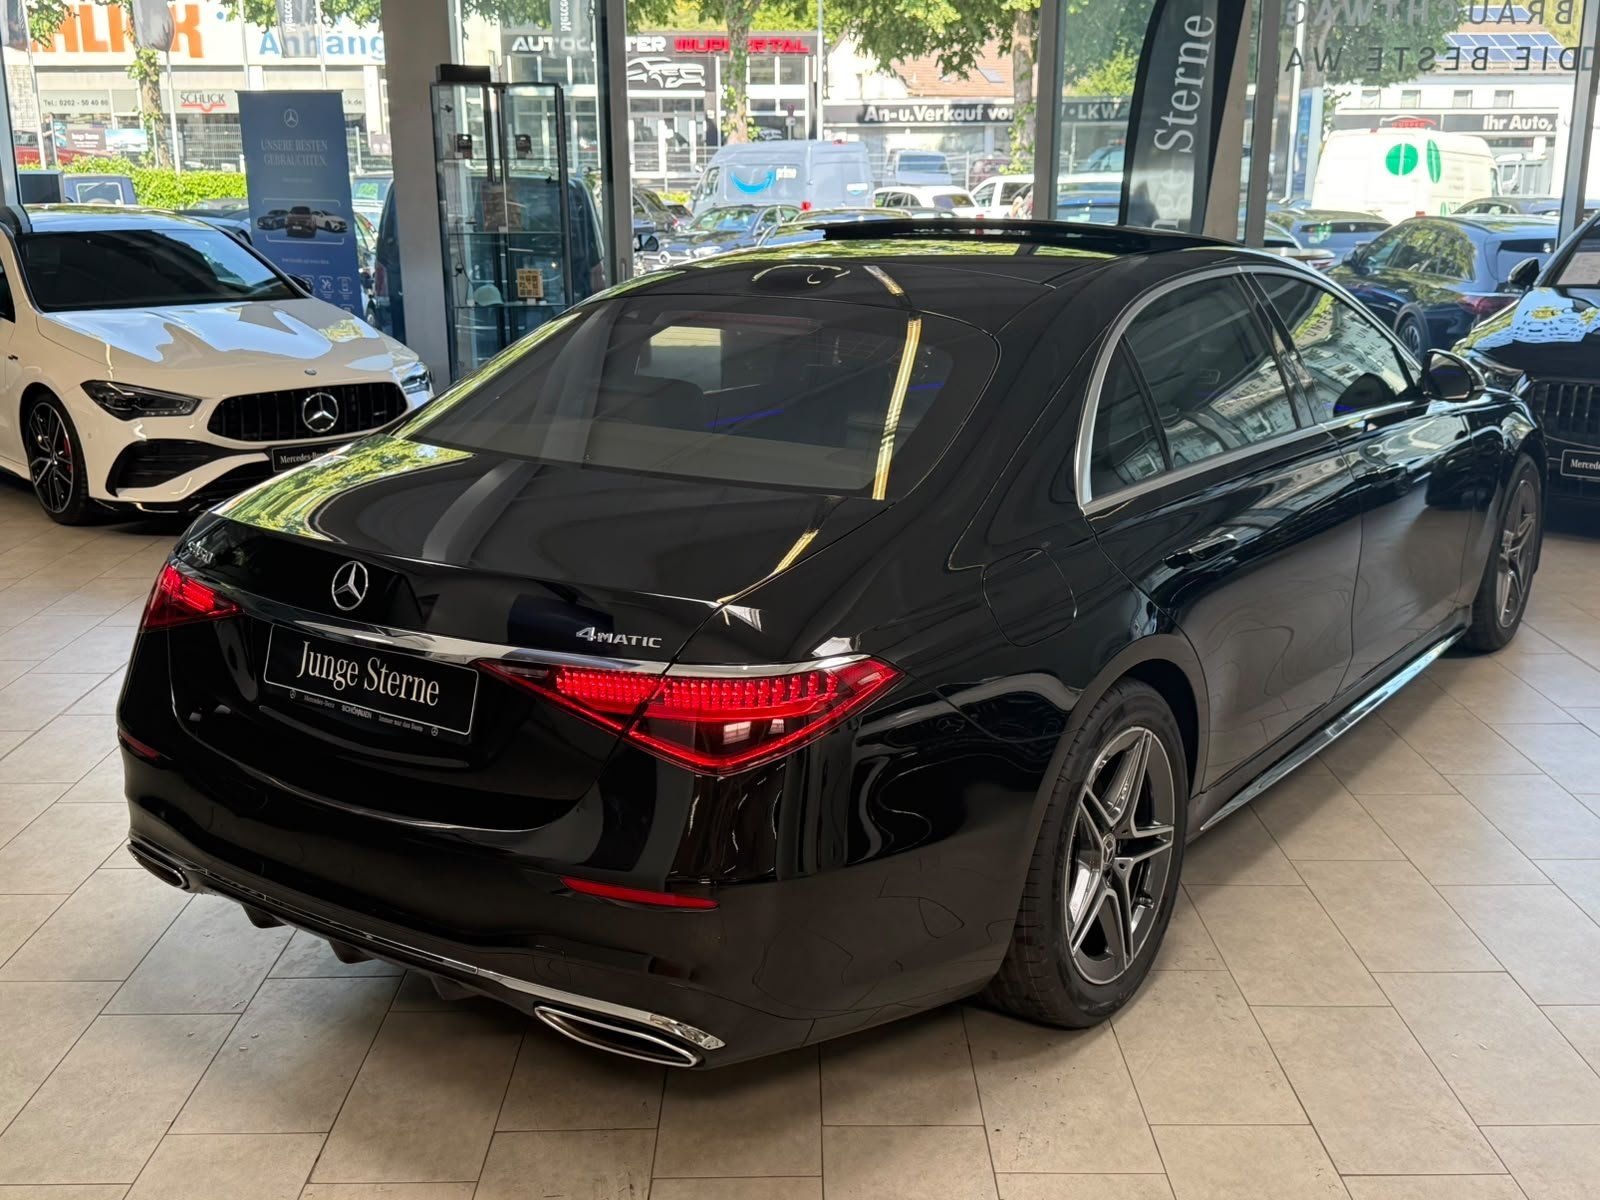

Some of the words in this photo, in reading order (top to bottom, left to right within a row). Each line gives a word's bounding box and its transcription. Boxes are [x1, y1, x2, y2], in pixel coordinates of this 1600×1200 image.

[1154, 15, 1214, 152] Sterne
[1077, 102, 1119, 120] LKW
[1483, 115, 1508, 130] Ihr
[1509, 115, 1553, 131] Auto,
[575, 626, 663, 648] 4MATIC
[296, 640, 359, 691] Junge
[363, 656, 440, 706] Sterne
